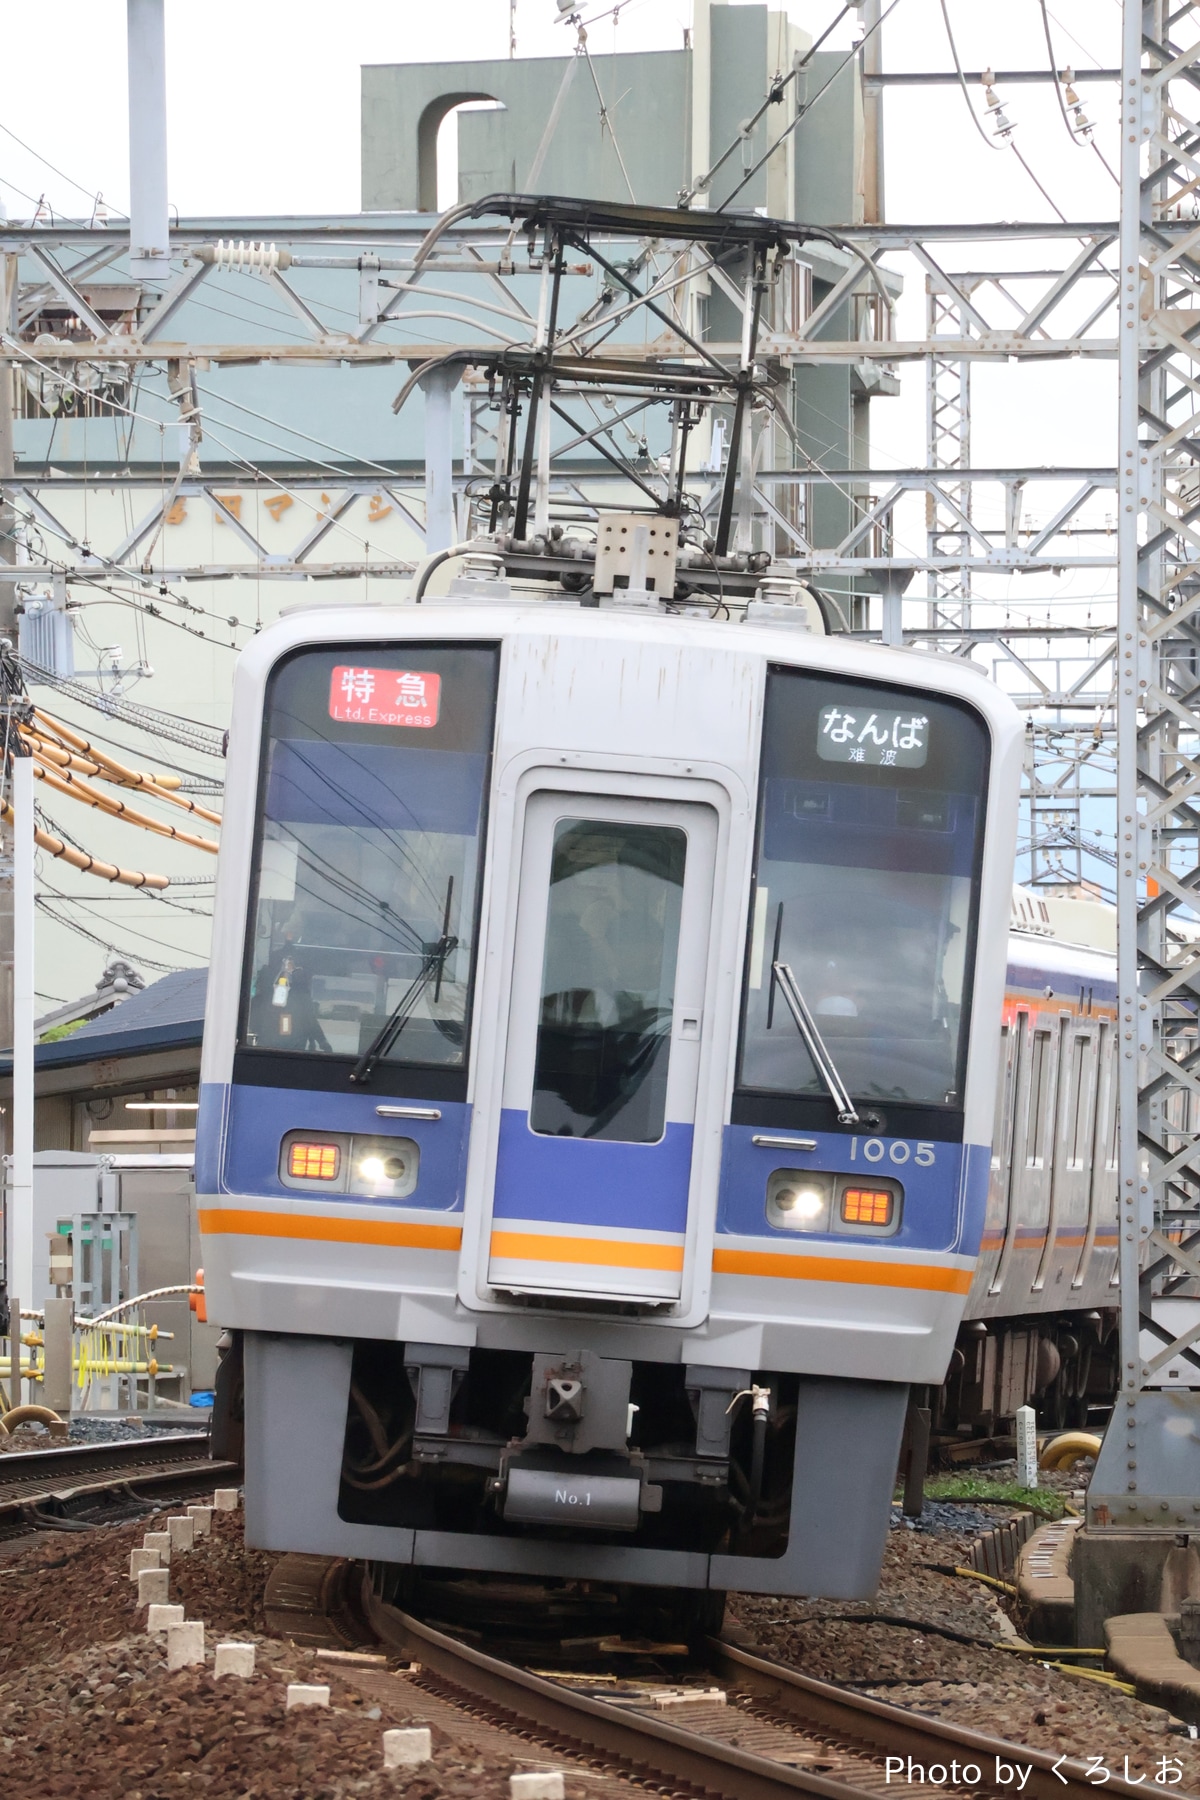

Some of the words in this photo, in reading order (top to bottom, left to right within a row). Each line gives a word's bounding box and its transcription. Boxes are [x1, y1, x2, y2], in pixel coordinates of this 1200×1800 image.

[341, 668, 428, 708] 特急
[823, 708, 928, 749] なんば
[850, 1136, 936, 1167] 1005
[555, 1489, 591, 1506] No.1
